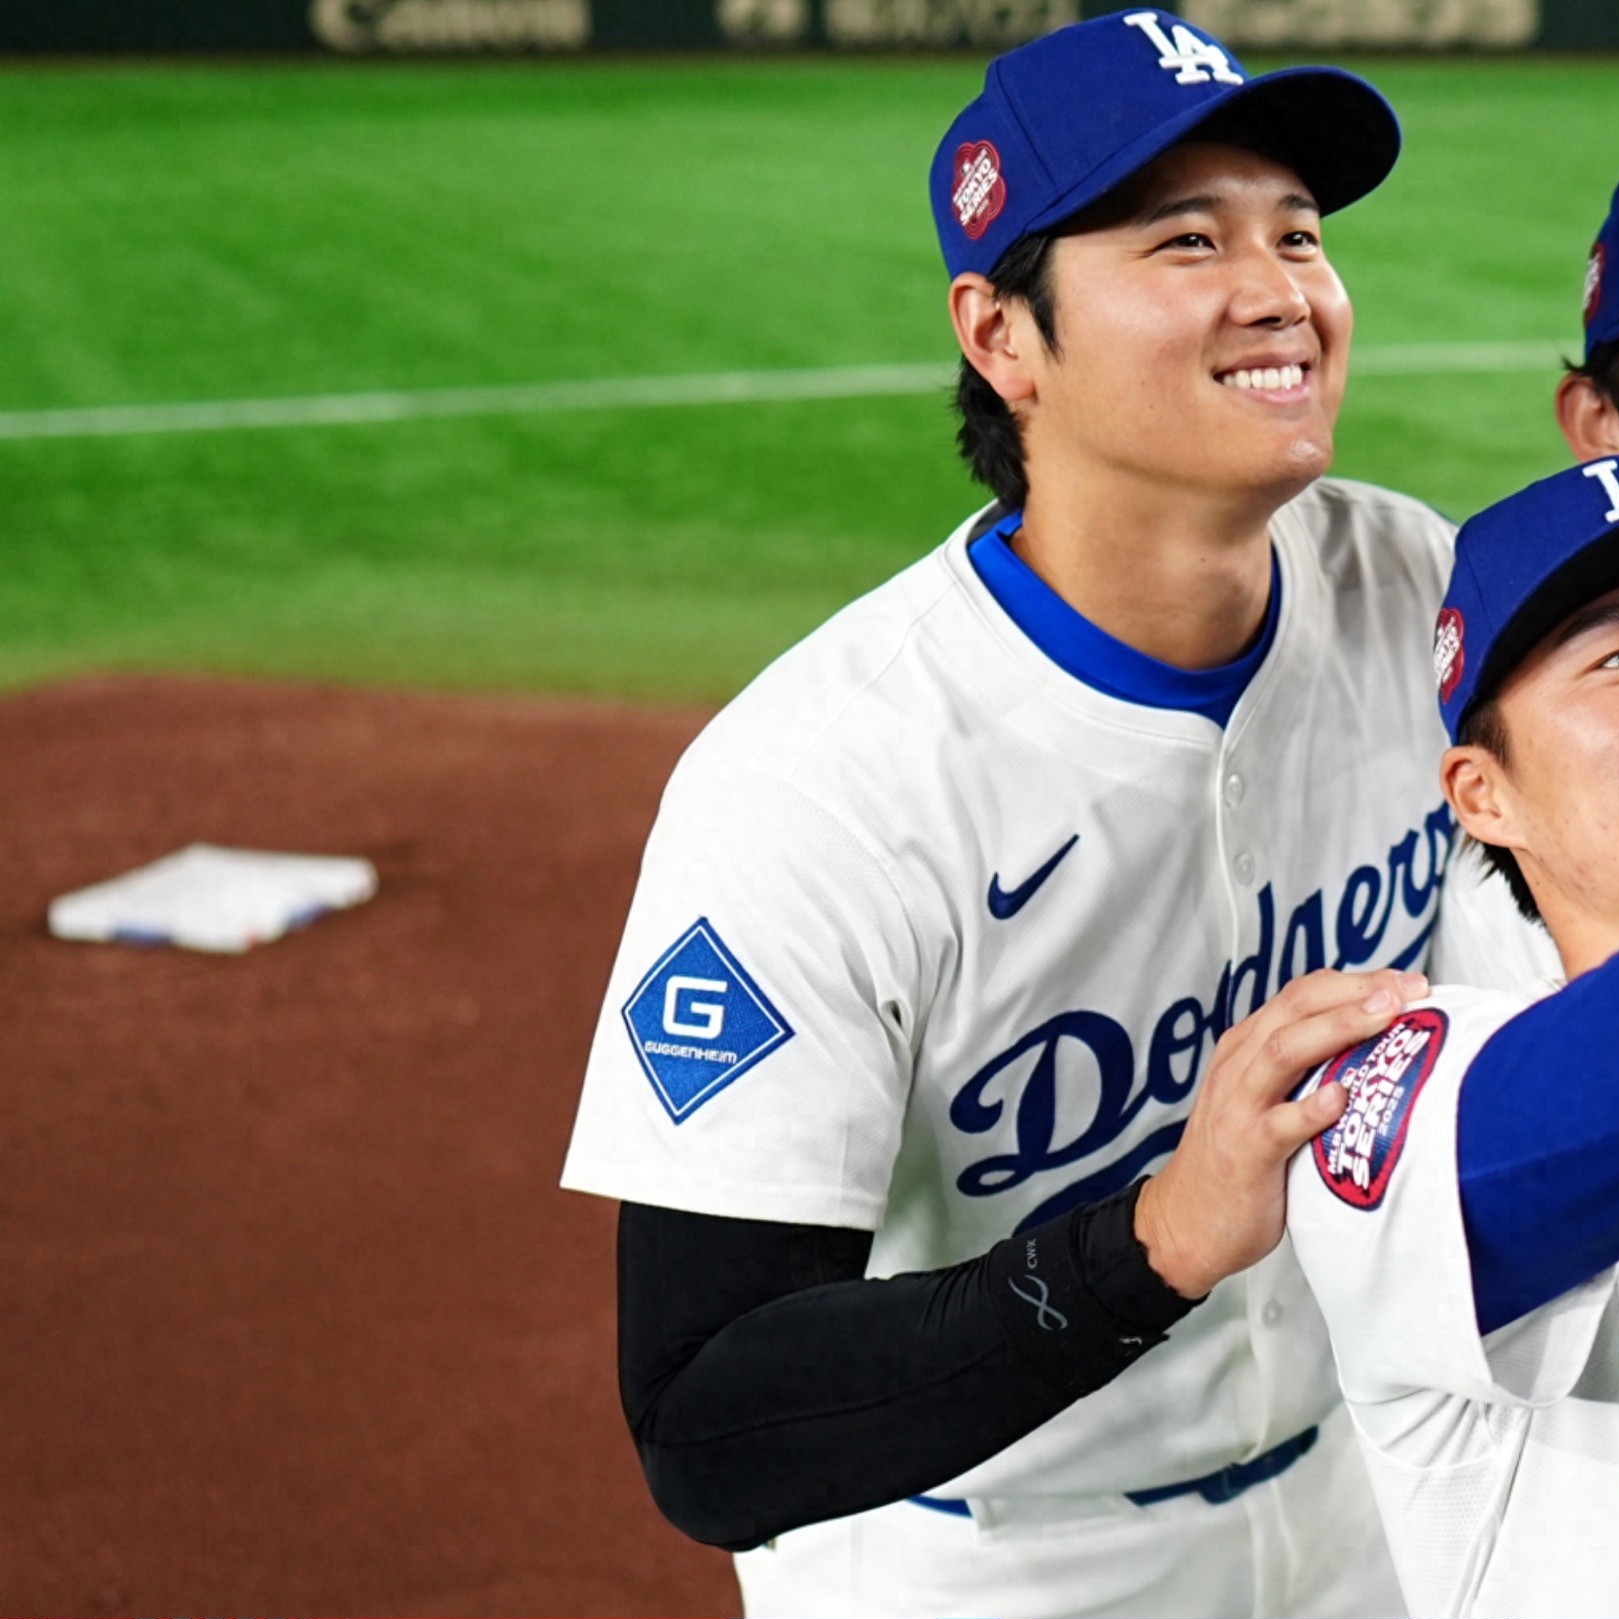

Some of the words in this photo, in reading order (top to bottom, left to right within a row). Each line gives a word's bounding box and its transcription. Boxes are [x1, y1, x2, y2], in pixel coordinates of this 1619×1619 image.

[1122, 12, 1245, 86] LA
[662, 975, 728, 1040] G
[1337, 1028, 1413, 1175] TOKYO
[1352, 1029, 1432, 1190] SERIES
